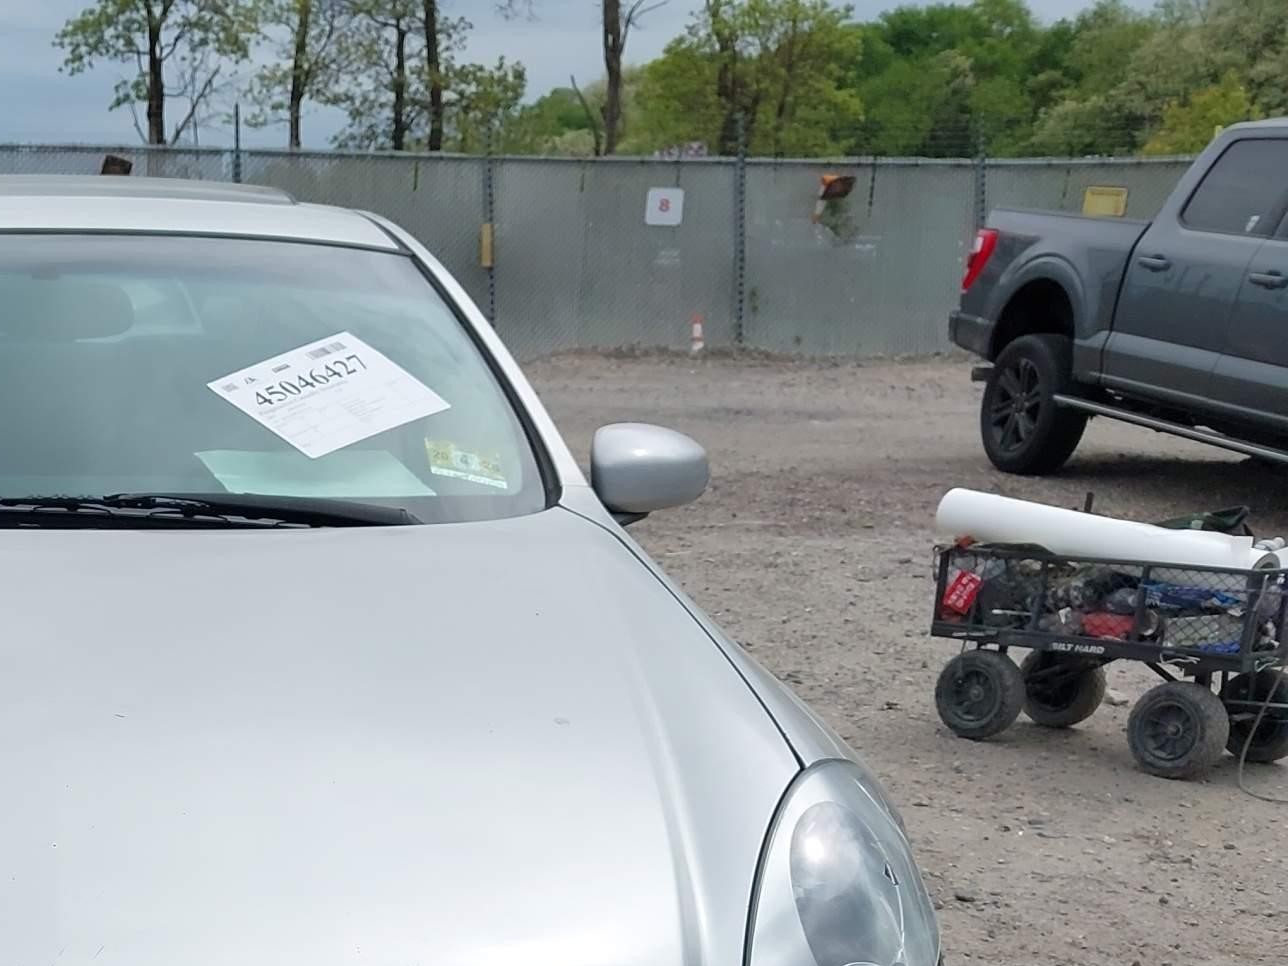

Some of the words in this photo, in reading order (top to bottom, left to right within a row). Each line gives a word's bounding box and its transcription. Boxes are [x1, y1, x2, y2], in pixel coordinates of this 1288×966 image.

[658, 198, 670, 213] 8
[255, 354, 367, 406] 45046427
[1074, 644, 1105, 655] HARD
